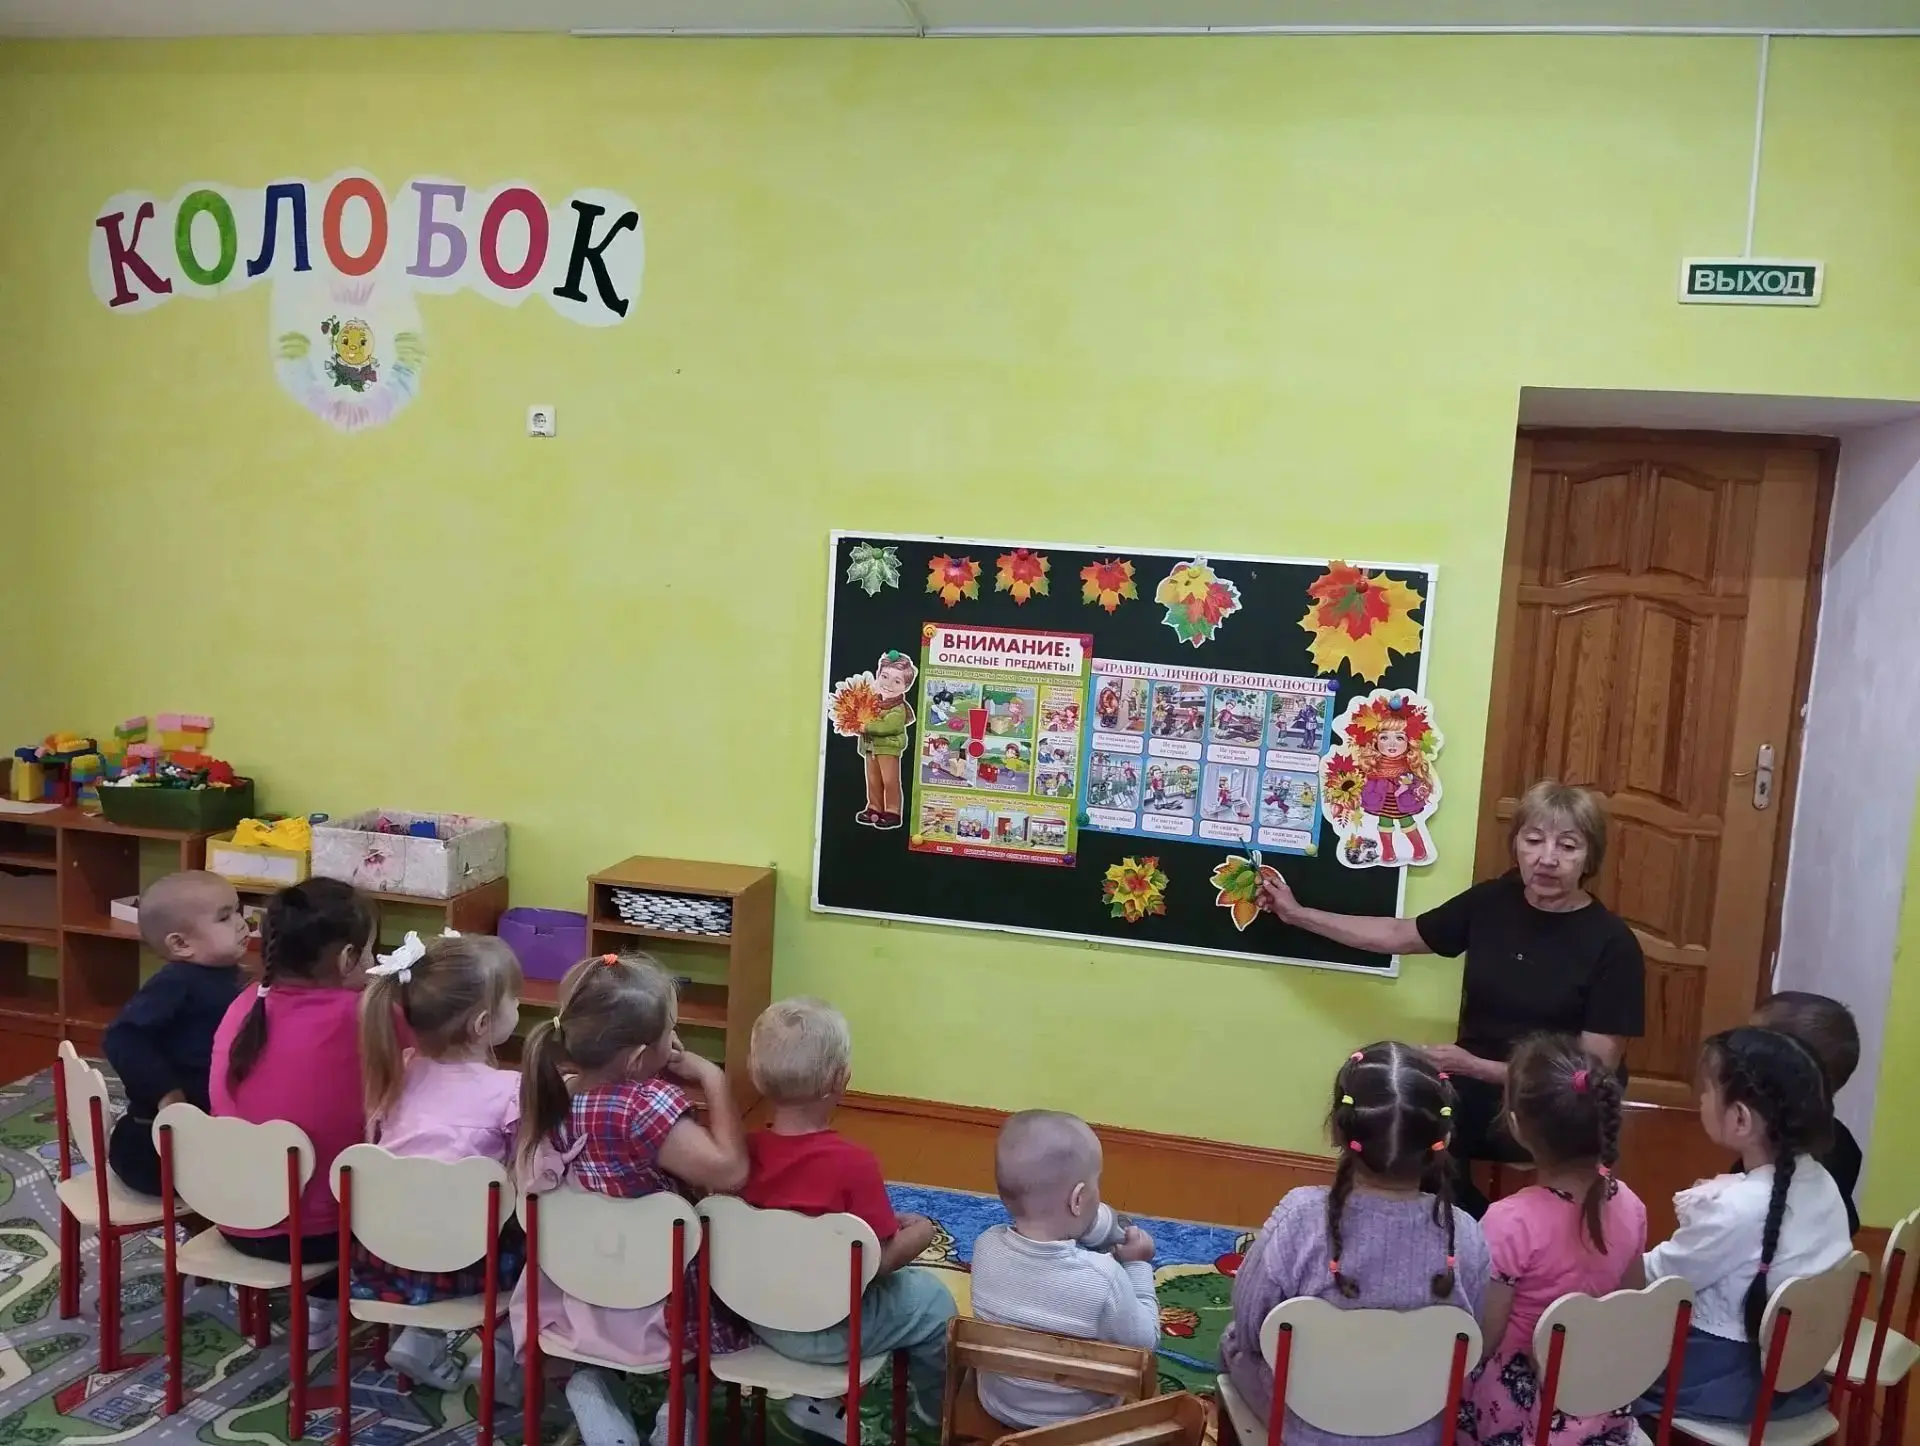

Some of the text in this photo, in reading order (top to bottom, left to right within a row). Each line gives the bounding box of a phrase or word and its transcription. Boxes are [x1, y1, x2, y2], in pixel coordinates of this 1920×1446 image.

[96, 177, 639, 318] КОЛОБОК
[1694, 269, 1806, 295] ВЫХОД
[943, 633, 1071, 658] ВНИМАНИЕ:
[939, 652, 1075, 673] ОПАСНЫЕ ПРЕДМЕТЫ!
[1161, 668, 1218, 683] ЛИЧНОЙ
[1222, 674, 1327, 693] БЕЗОПАСНОСТИ
